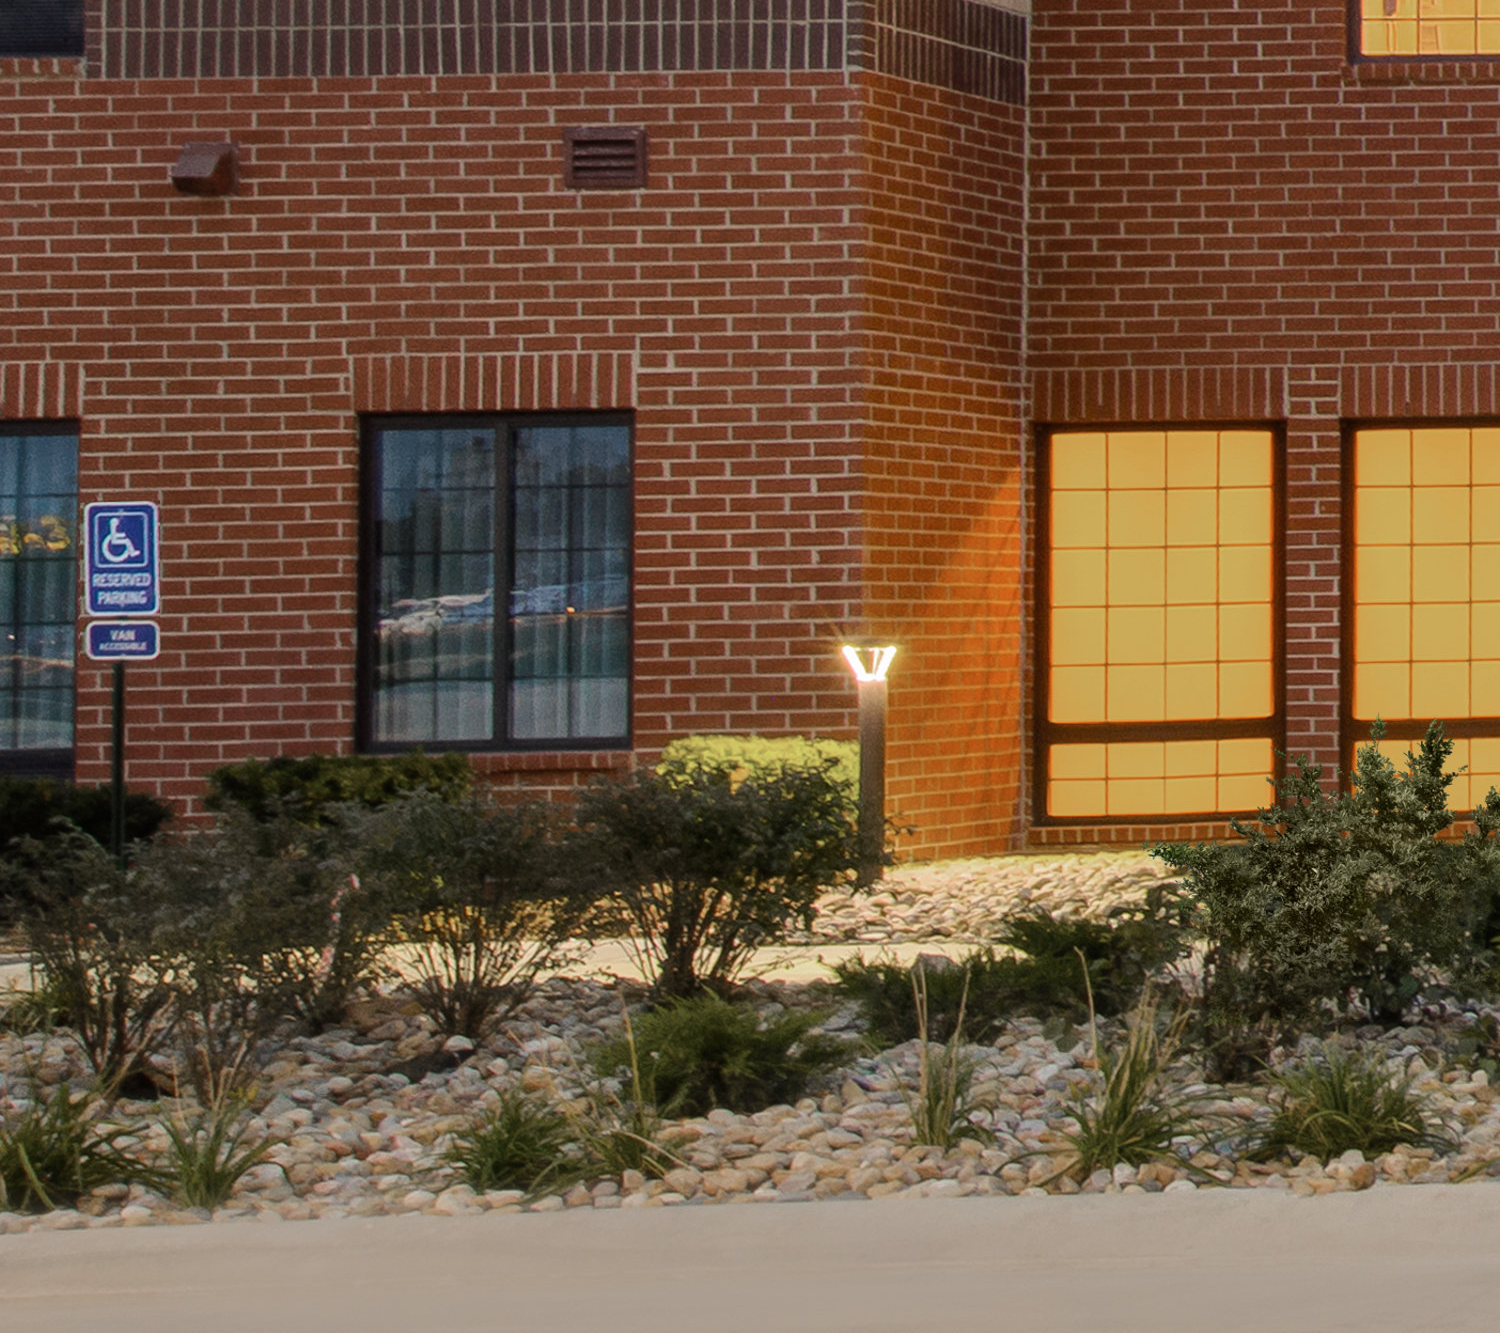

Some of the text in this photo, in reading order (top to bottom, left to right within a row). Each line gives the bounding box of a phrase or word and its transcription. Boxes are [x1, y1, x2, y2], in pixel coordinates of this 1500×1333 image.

[92, 573, 151, 587] RESERVED
[97, 591, 147, 605] PARKING
[110, 630, 136, 641] VAN
